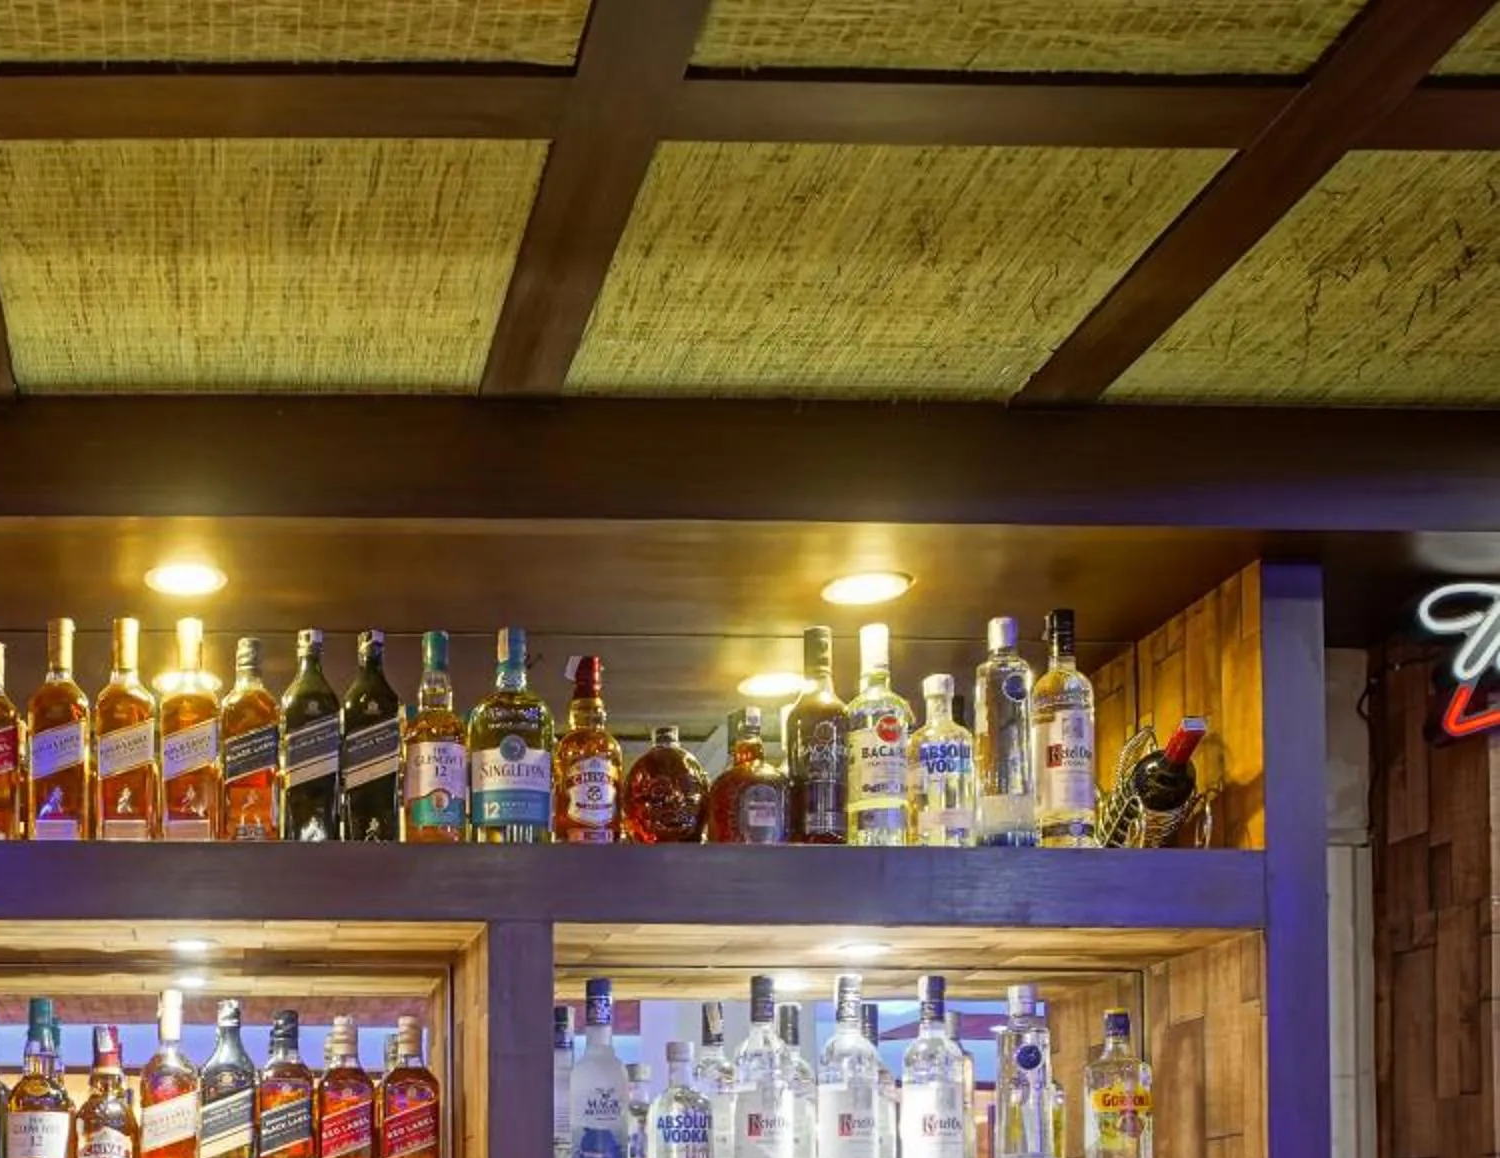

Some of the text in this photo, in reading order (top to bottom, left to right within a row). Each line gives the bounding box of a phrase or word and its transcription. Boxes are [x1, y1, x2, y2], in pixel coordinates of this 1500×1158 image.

[484, 801, 501, 819] 12
[657, 1115, 712, 1129] ABSOLUT
[662, 1129, 709, 1143] VODKA
